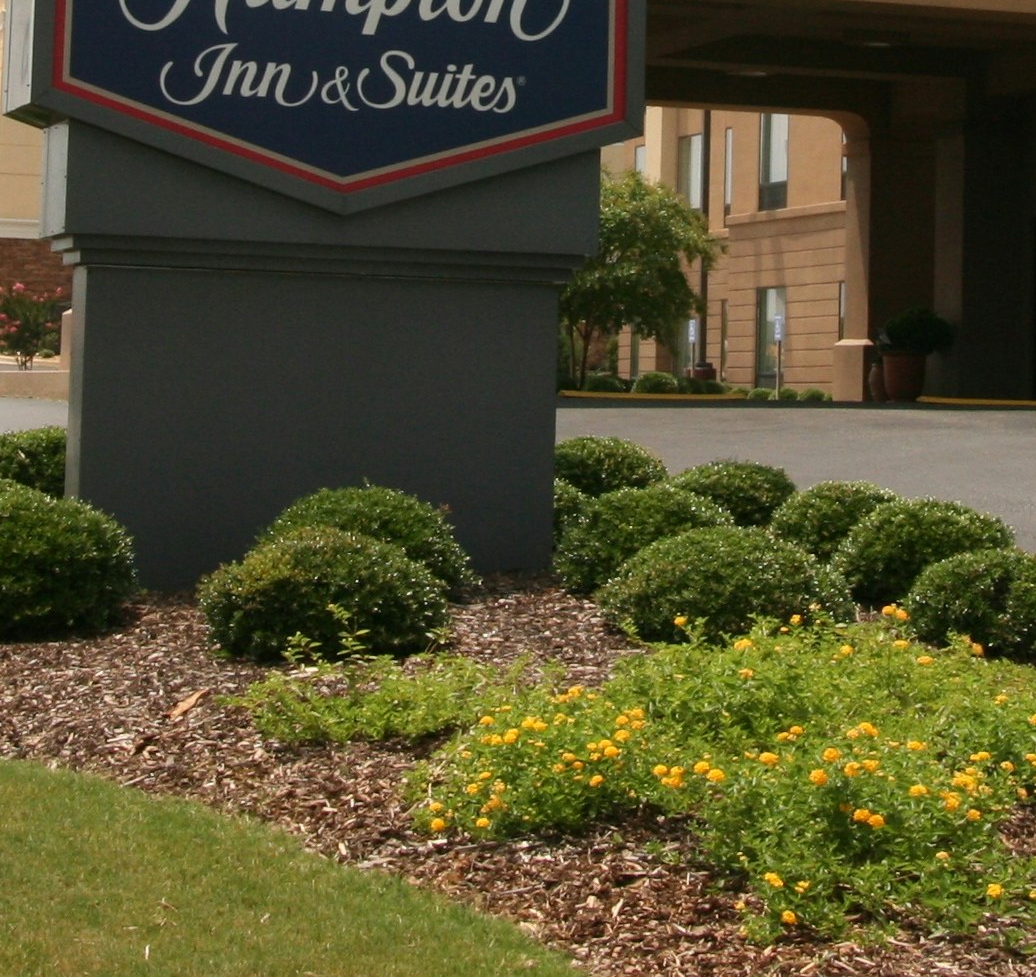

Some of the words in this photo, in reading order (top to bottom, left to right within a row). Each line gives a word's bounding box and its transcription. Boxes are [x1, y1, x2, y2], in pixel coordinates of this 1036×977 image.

[159, 43, 318, 107] Inn
[320, 66, 359, 112] &
[356, 49, 517, 114] Suites
